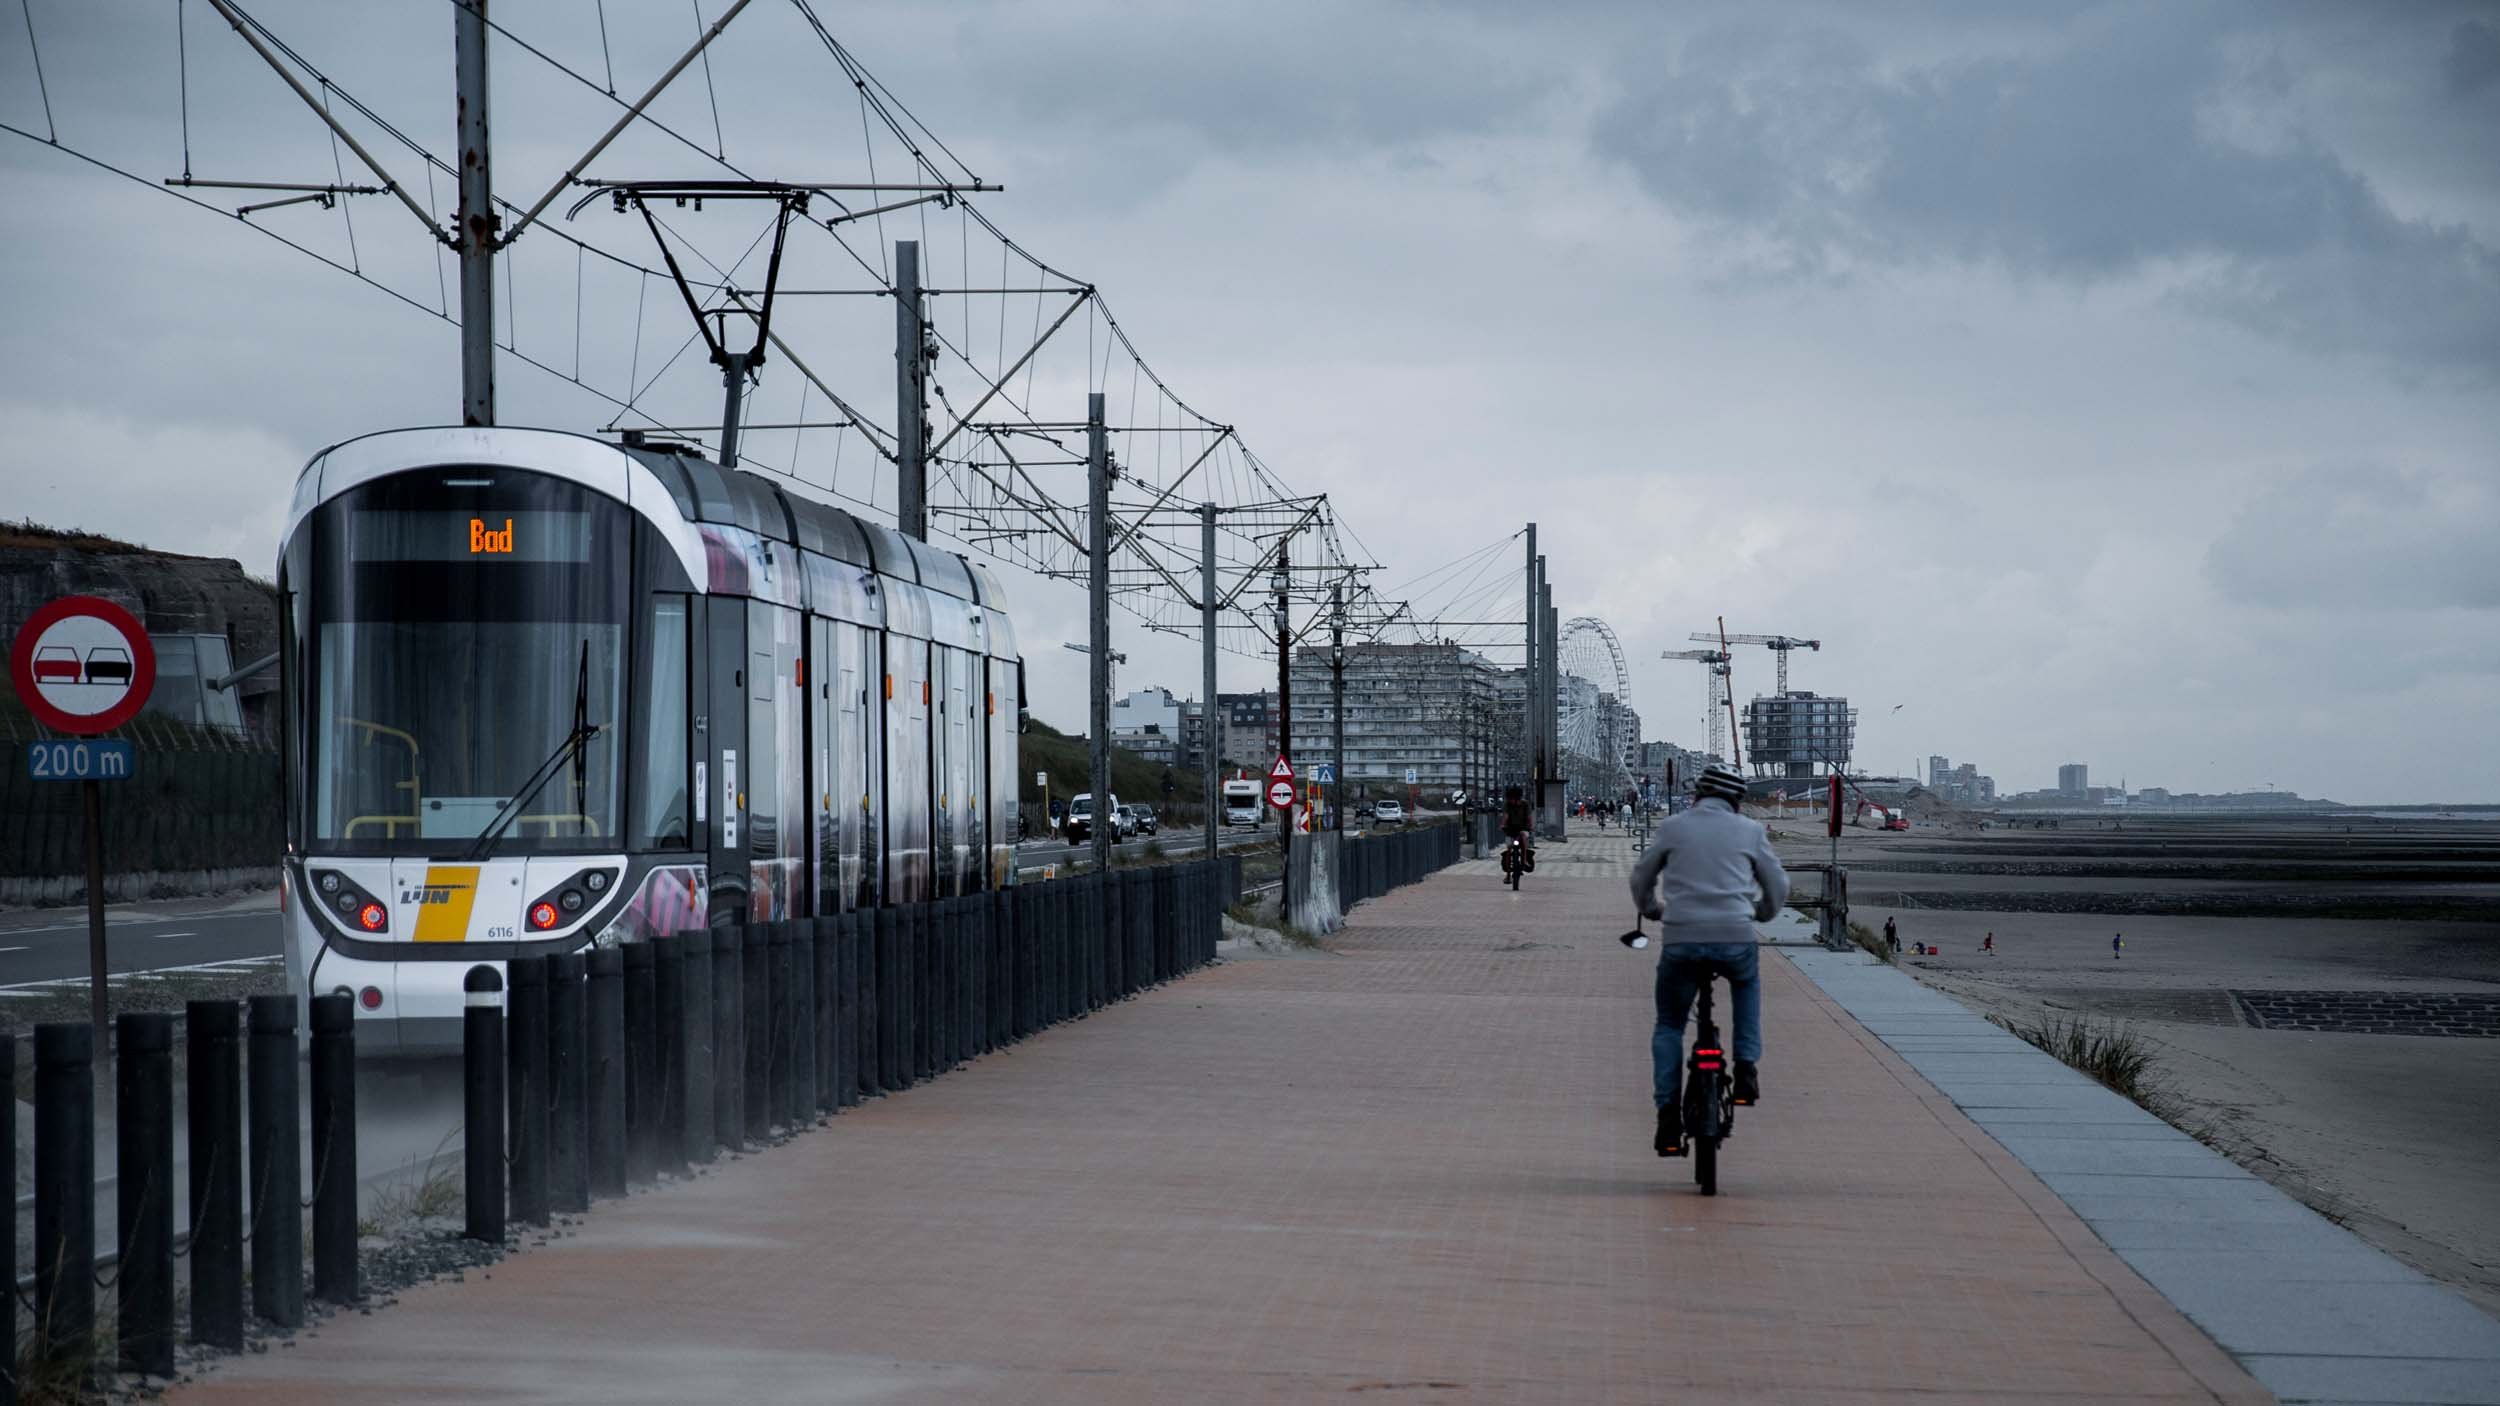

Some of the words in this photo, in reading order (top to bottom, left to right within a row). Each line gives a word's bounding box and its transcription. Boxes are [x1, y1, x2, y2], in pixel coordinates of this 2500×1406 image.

[470, 518, 513, 553] Bad
[32, 744, 89, 776] 200
[100, 751, 125, 775] m
[487, 926, 513, 938] 6116
